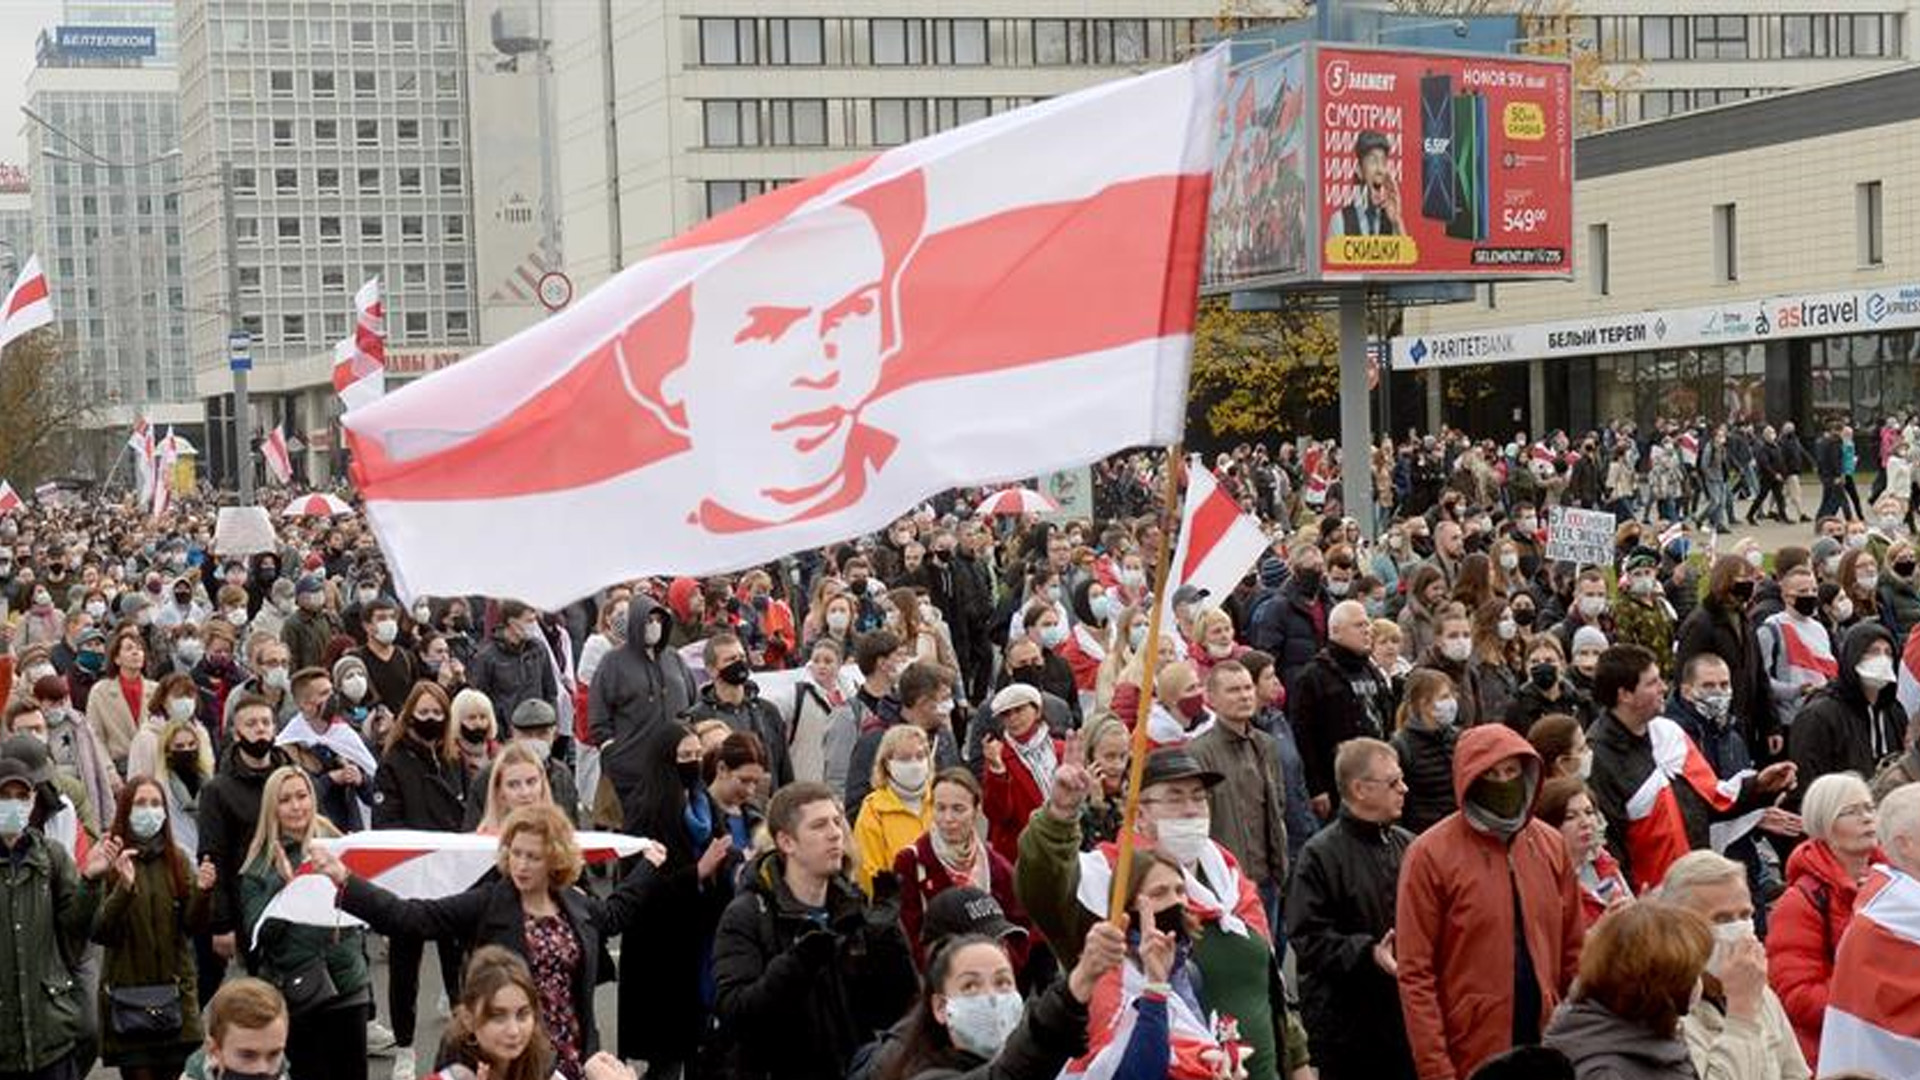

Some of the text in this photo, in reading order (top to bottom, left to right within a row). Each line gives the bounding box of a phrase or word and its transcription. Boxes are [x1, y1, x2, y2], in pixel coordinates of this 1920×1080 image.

[1462, 68, 1506, 87] HONOR
[1343, 240, 1400, 261] СКИДКИ
[1778, 296, 1859, 329] astravel
[1431, 334, 1514, 360] PARITETBANK
[1548, 323, 1647, 350] БЕЛЫЙ ТЕРЕМ
